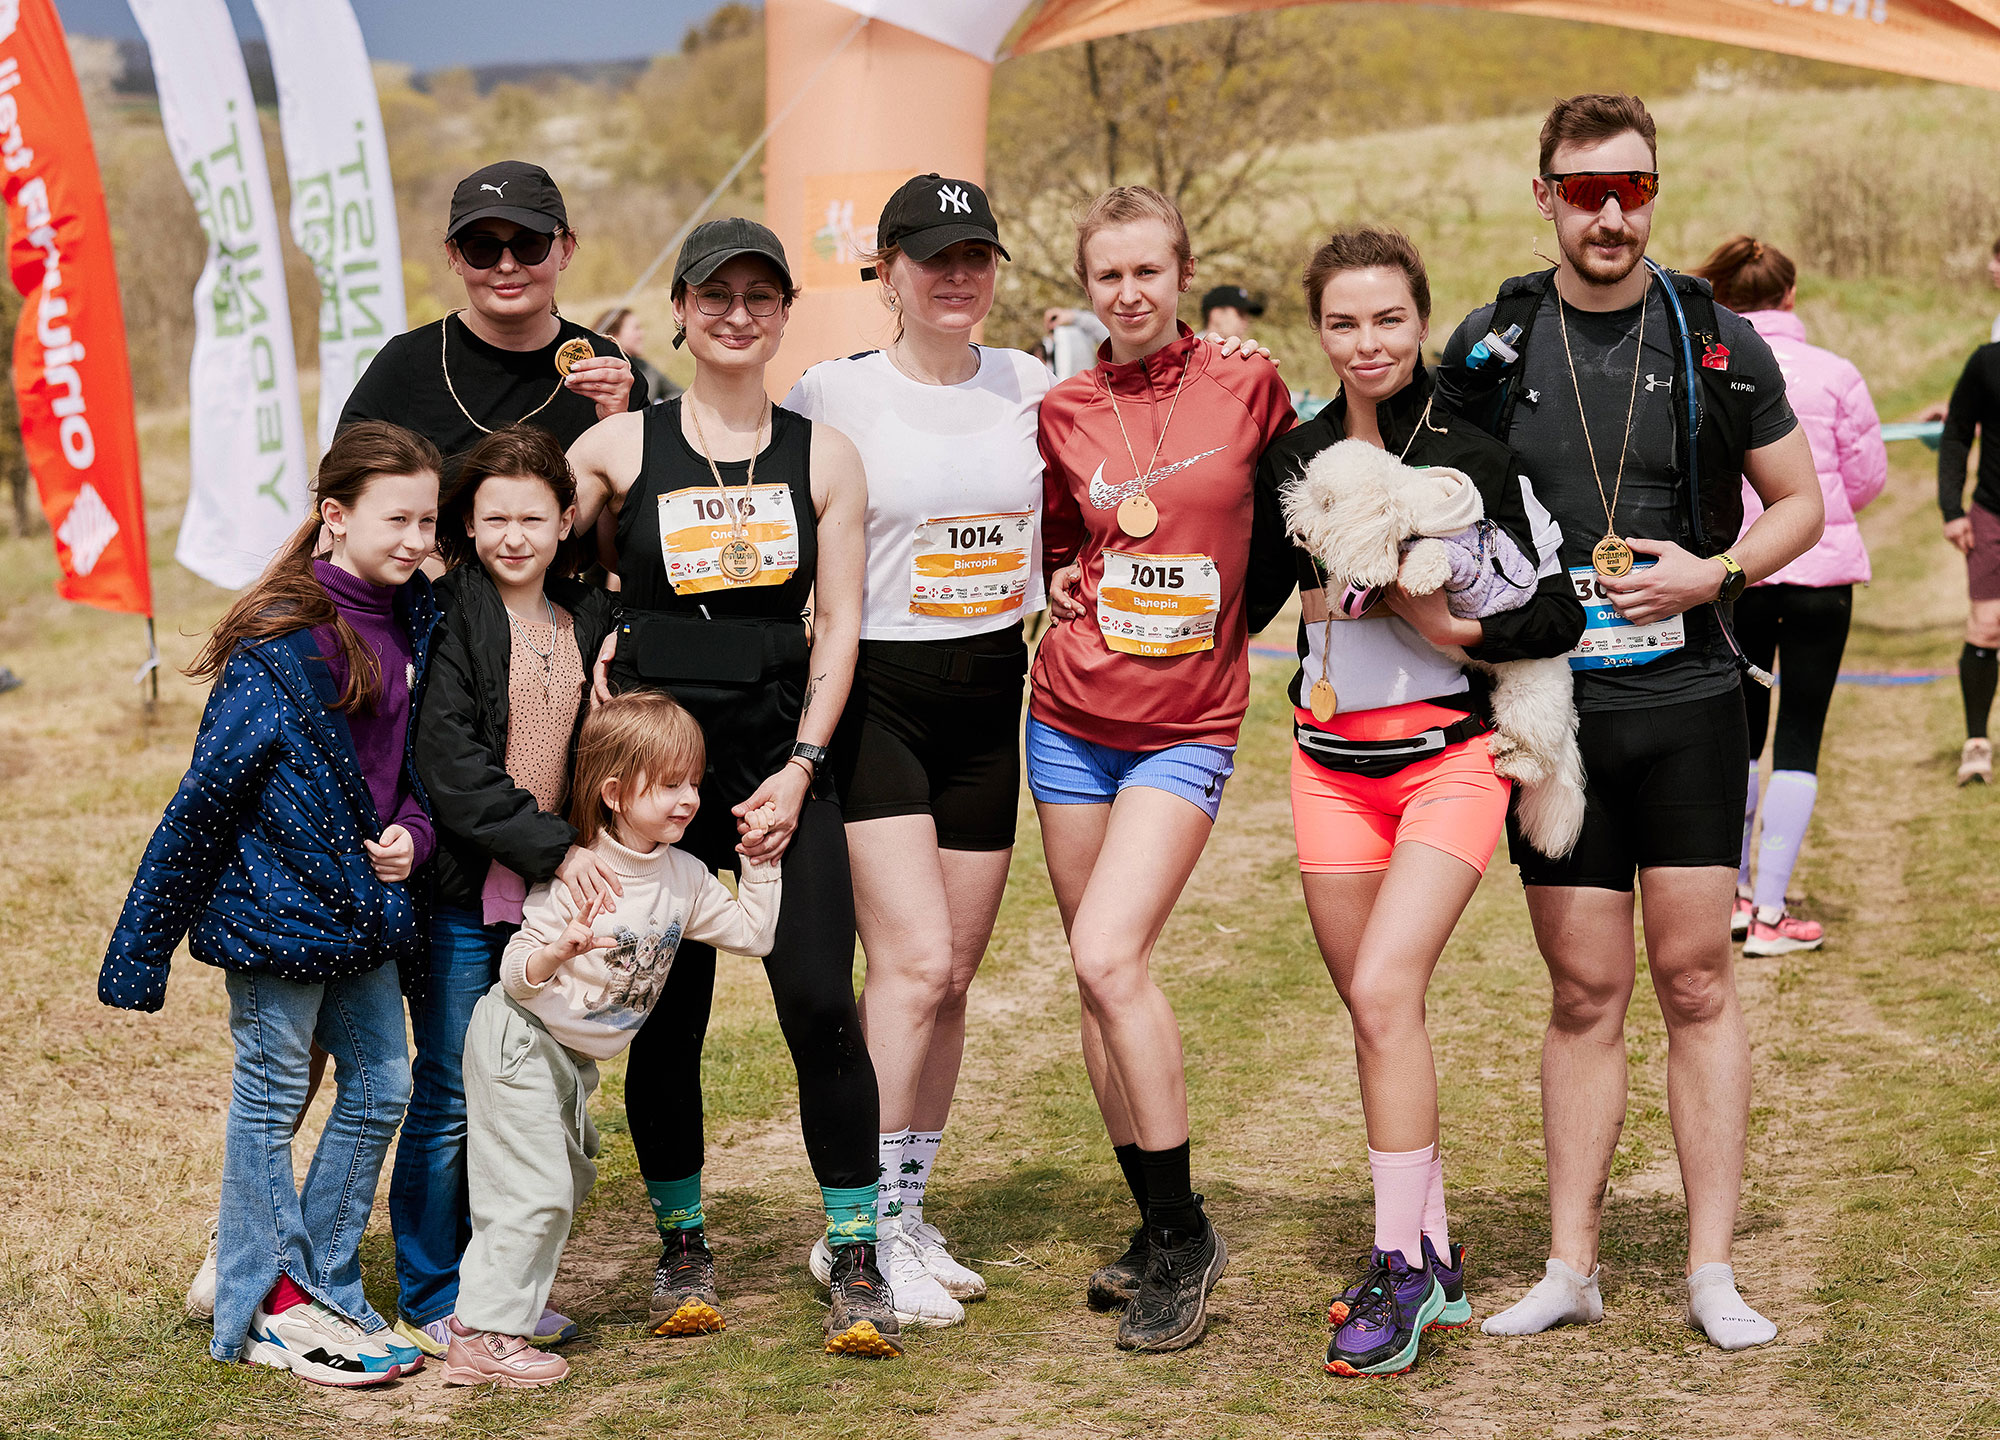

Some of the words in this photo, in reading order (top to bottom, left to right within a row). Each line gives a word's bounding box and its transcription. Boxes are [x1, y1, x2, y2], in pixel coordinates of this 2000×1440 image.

[936, 184, 973, 215] NY
[710, 529, 750, 541] Олеа
[947, 524, 1004, 549] 1014
[953, 557, 998, 570] Вікторія
[1130, 563, 1185, 589] 1015
[1133, 596, 1179, 610] Валерія
[962, 606, 974, 615] 10
[975, 606, 987, 614] км
[1140, 644, 1151, 654] 10
[1153, 646, 1167, 655] км
